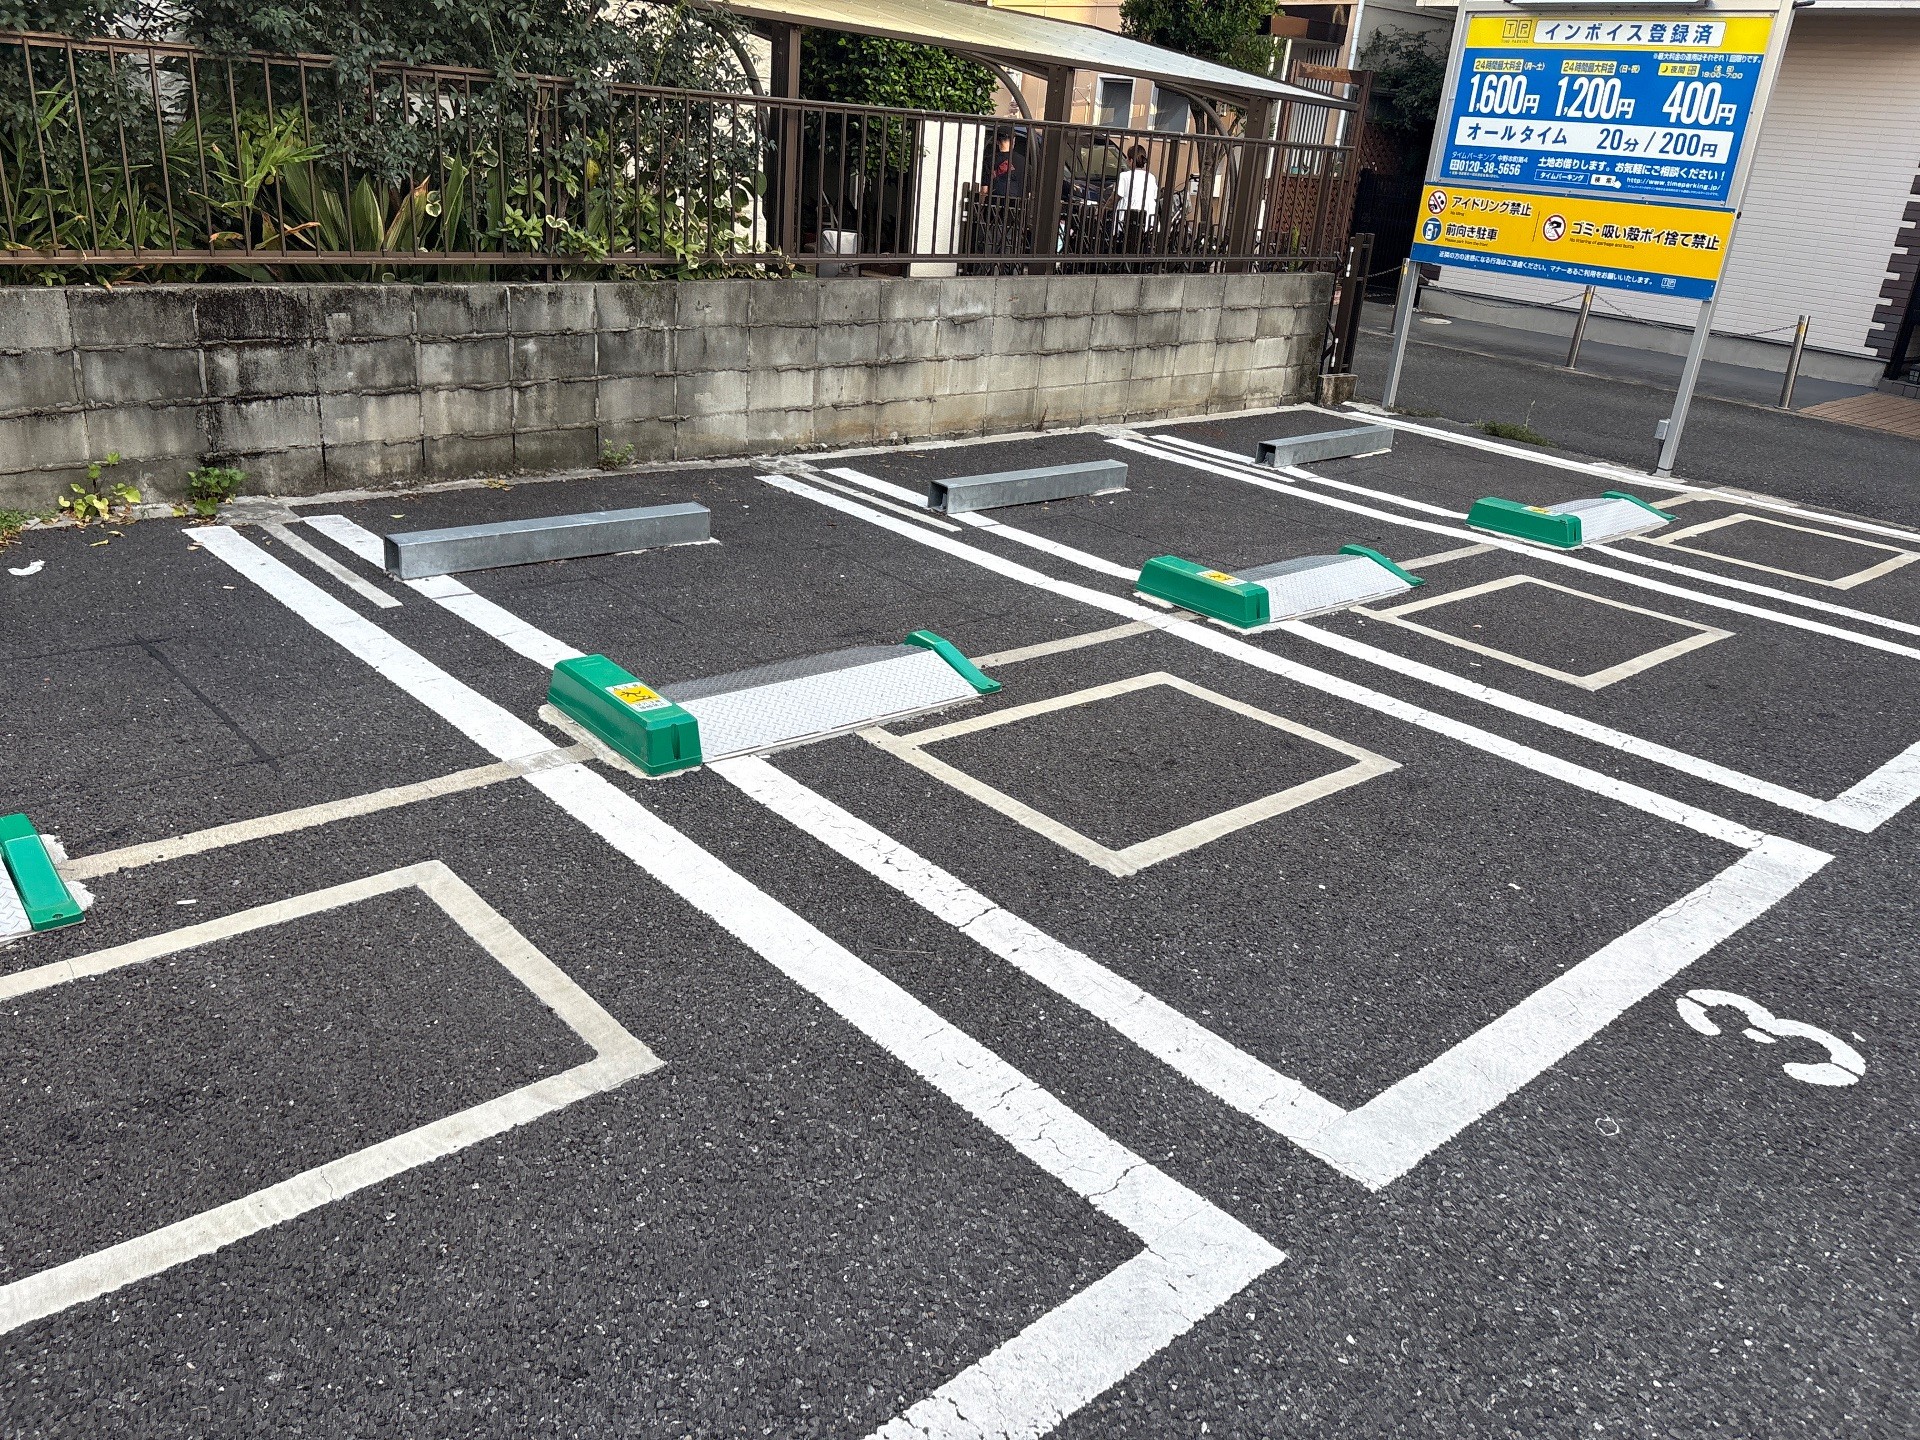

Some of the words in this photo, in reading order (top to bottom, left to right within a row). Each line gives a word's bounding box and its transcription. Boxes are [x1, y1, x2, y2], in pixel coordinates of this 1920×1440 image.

[1545, 22, 1714, 44] インボイス登録済
[1475, 60, 1522, 71] 24時間最大料金
[1563, 61, 1615, 73] 24時間最大料金
[1670, 65, 1686, 74] 夜間
[1468, 74, 1540, 115] 1,600円
[1555, 76, 1635, 120] 1,200円
[1662, 80, 1737, 126] 400円
[1467, 122, 1567, 145] オールタイム
[1451, 151, 1496, 161] タイムパーキング
[1459, 159, 1521, 176] 0120-38-5656
[1540, 172, 1584, 182] タイムパーキング
[1626, 176, 1721, 191] http://www.timeparking.jp/
[1451, 196, 1532, 217] アイドリング禁止
[1445, 222, 1499, 241] 前向き駐車
[1571, 221, 1720, 251] ゴミ・吸い殻ポイ捨て禁止
[1675, 989, 1866, 1087] 3
